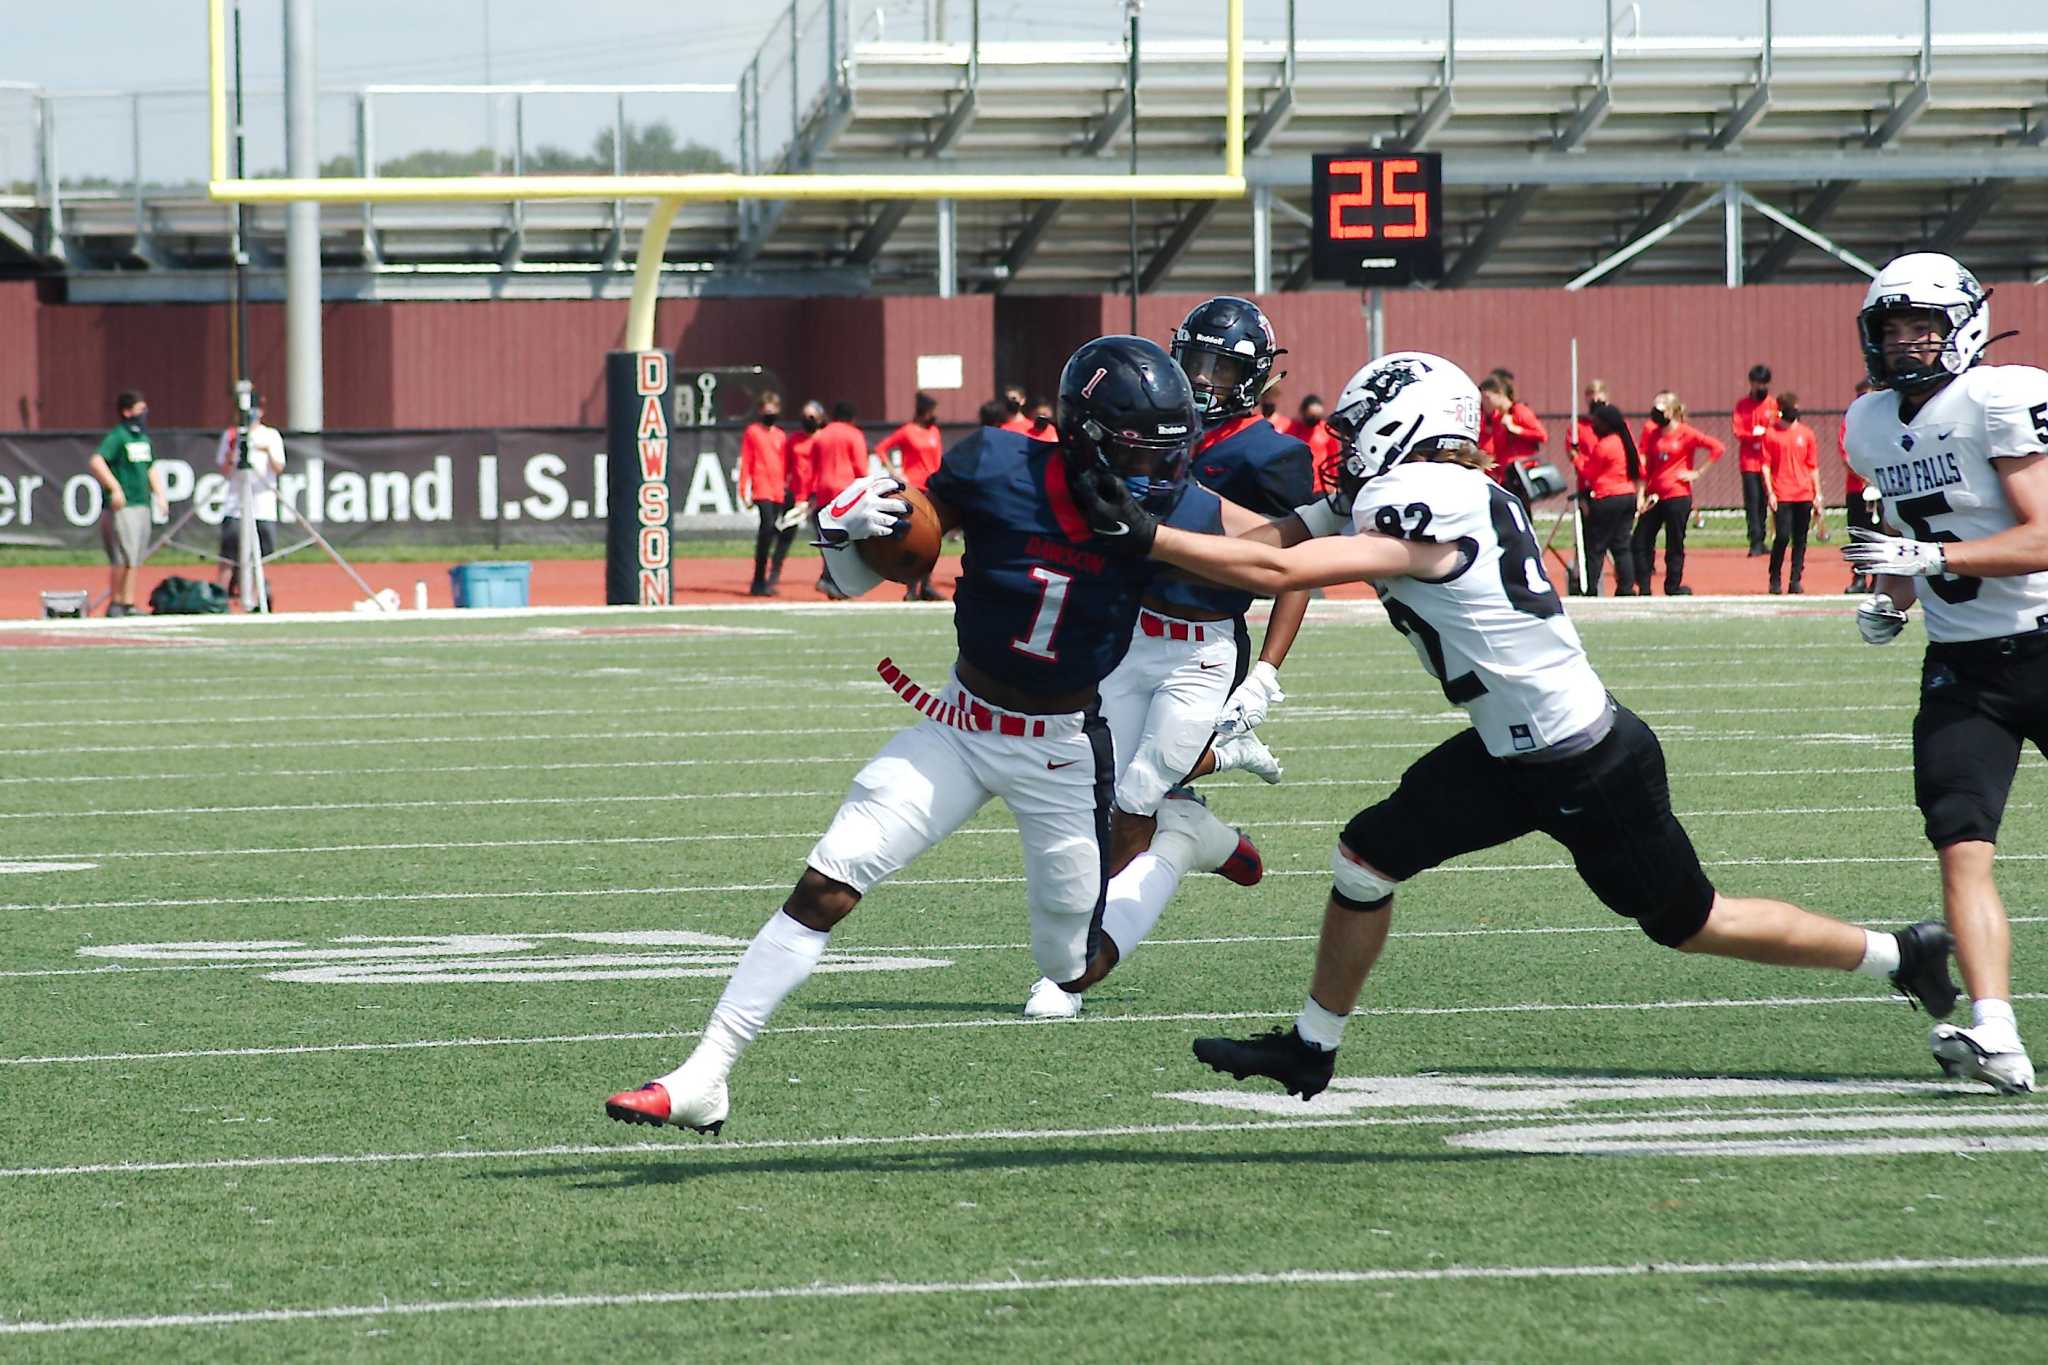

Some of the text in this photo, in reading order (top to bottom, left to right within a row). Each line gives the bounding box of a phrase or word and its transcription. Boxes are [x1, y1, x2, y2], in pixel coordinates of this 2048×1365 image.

[1329, 160, 1427, 239] 25
[151, 453, 452, 526] Perland
[637, 352, 669, 605] DAWSON
[1912, 452, 1963, 492] FALLS
[1896, 490, 1983, 605] 5
[1008, 564, 1074, 664] 1
